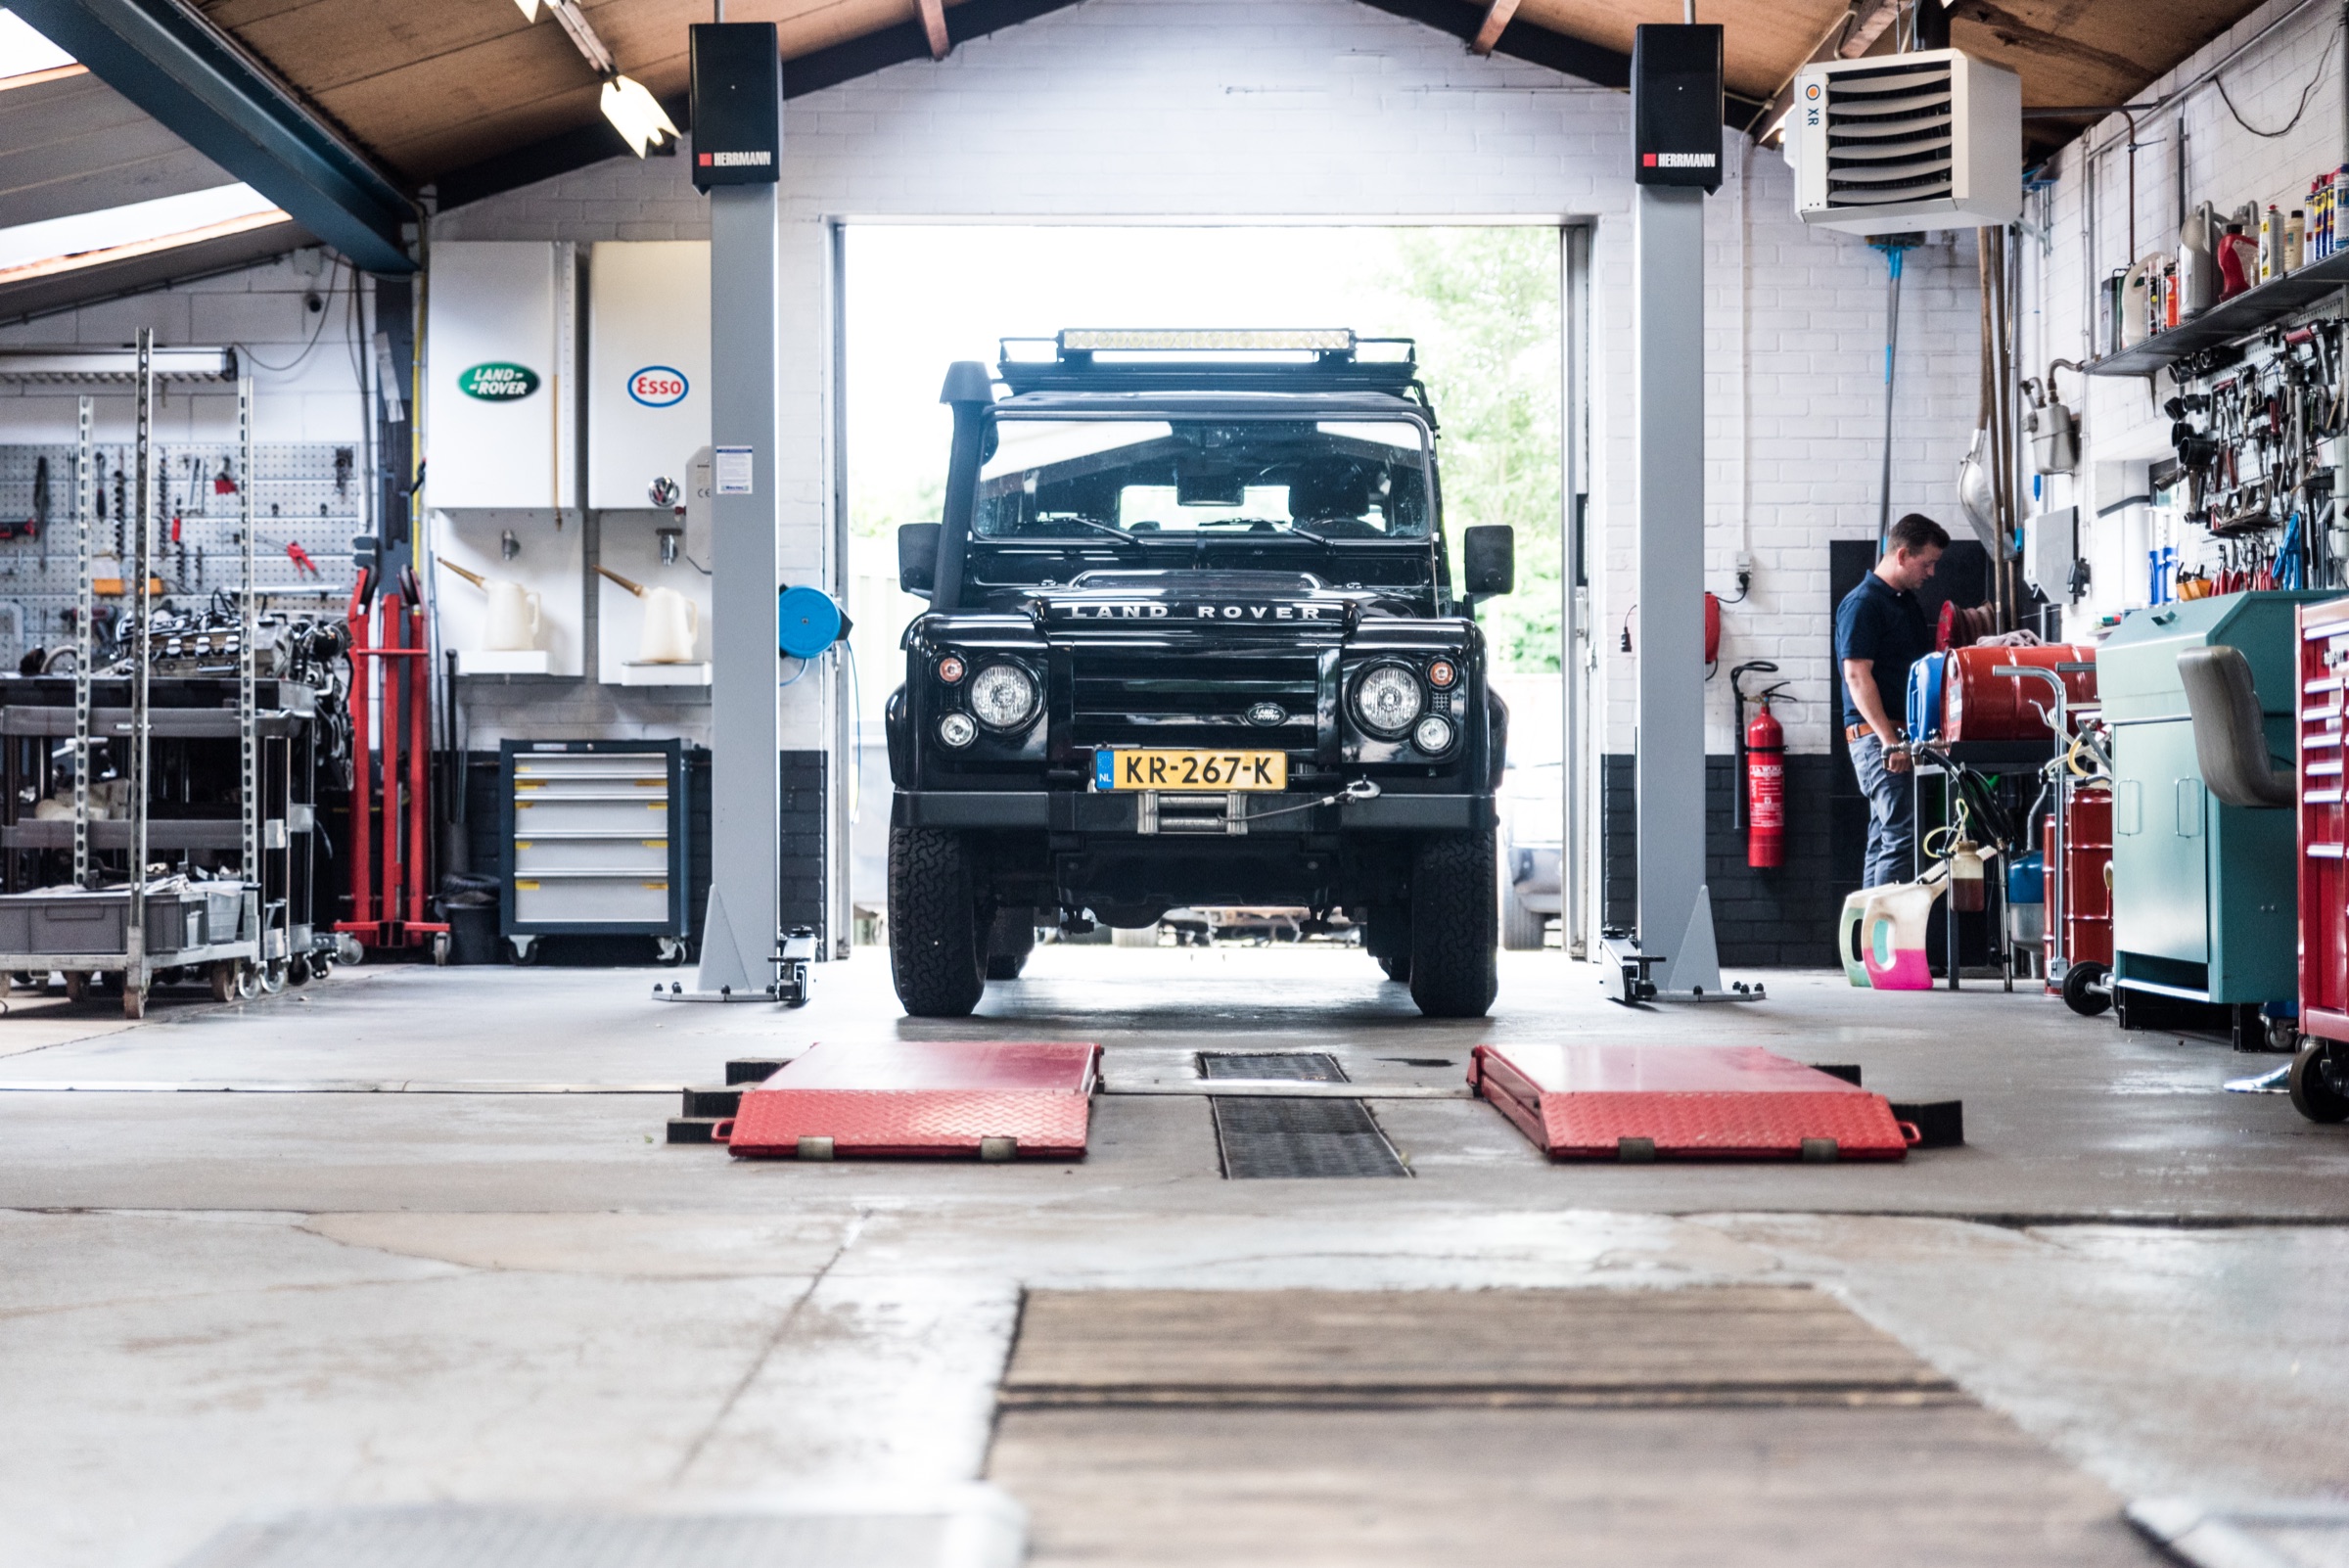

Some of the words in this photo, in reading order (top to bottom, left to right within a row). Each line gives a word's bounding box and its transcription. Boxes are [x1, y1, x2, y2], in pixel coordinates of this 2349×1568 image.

[1808, 108, 1819, 126] XR
[714, 151, 771, 166] HERRMANN
[1658, 153, 1716, 167] HERRMANN
[1071, 605, 1169, 619] LAND
[1198, 606, 1320, 620] ROVER
[1099, 773, 1112, 782] NL
[1126, 757, 1273, 784] KR-267-K
